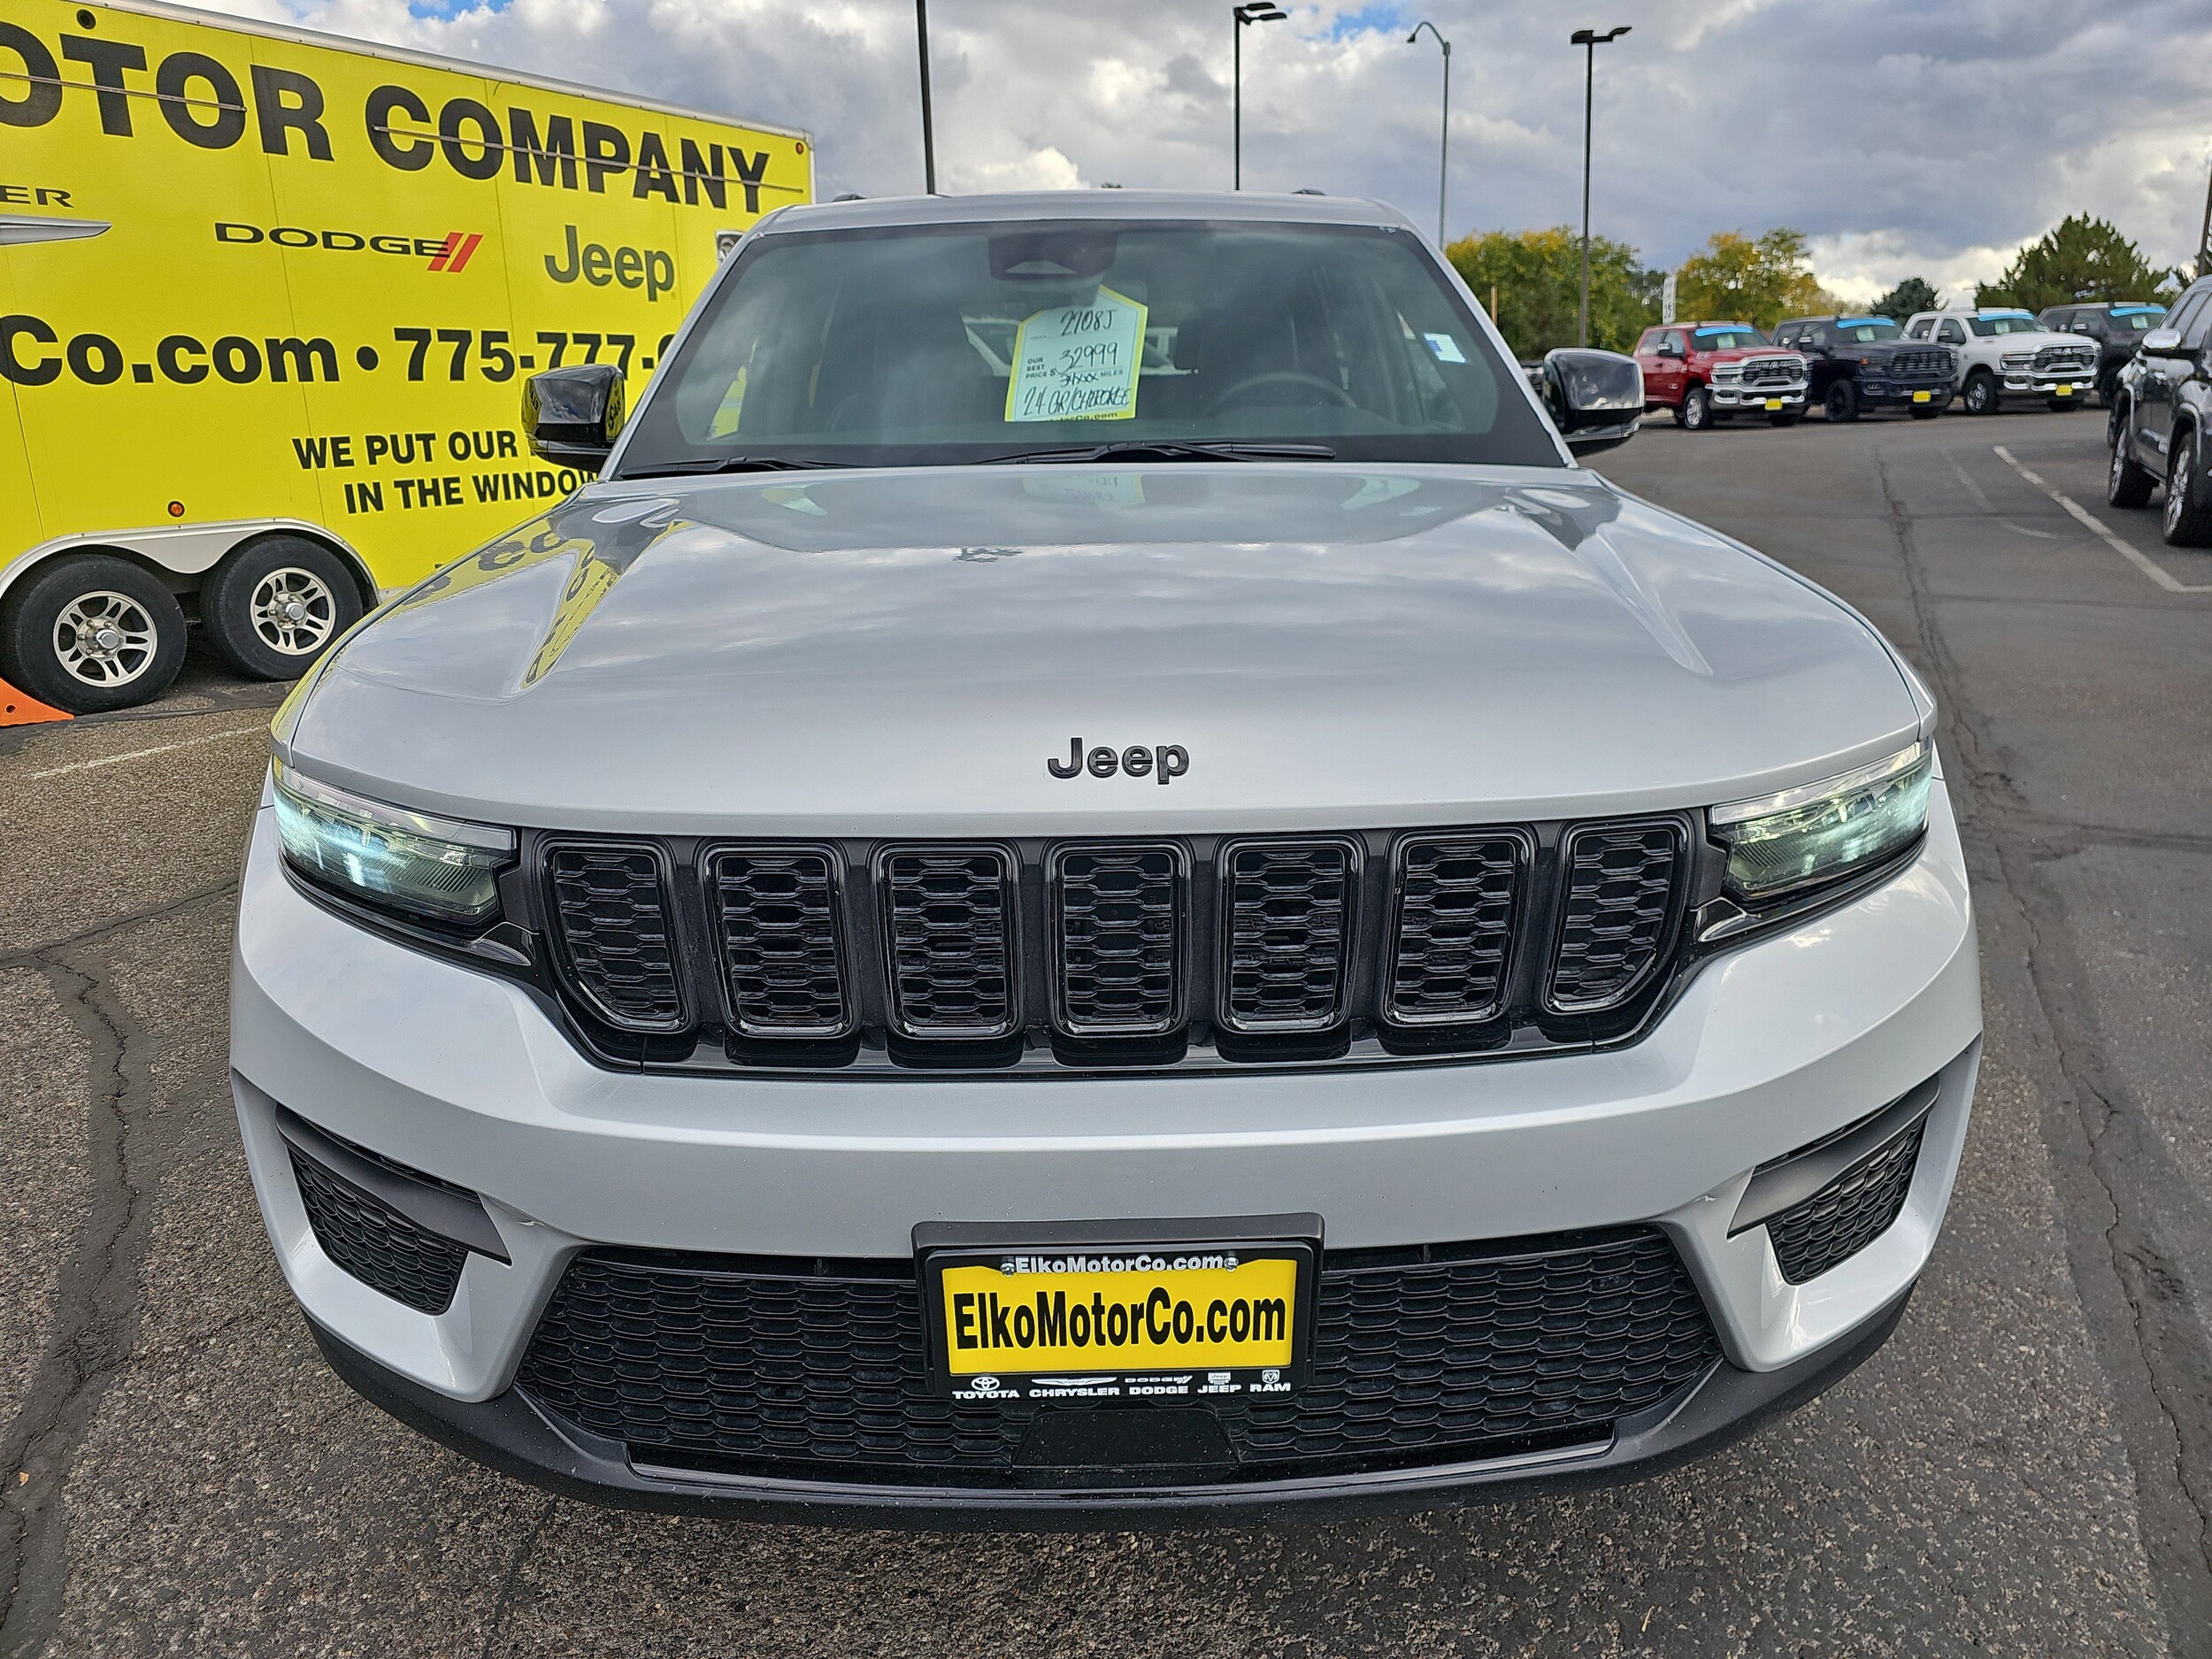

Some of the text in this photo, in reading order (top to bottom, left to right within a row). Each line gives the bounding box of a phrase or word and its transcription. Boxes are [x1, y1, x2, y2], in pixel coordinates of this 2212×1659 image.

[0, 20, 771, 213] OTOR COMPANY
[214, 221, 451, 258] DODGE
[544, 225, 676, 303] Jeep
[0, 314, 341, 386] Co.com
[1058, 342, 1118, 374] 32999
[1023, 386, 1048, 416] 24
[292, 431, 518, 470] WE PUT OUR
[343, 481, 385, 515] IN
[394, 476, 465, 510] THE
[1047, 736, 1190, 785] Jeep
[1015, 1254, 1224, 1274] ElkoMotorCo.com
[954, 1286, 1285, 1349] ElkoMotorCo.com
[952, 1382, 1292, 1400] TOYOTA CHRYSLER DODGE JEEP RAM
